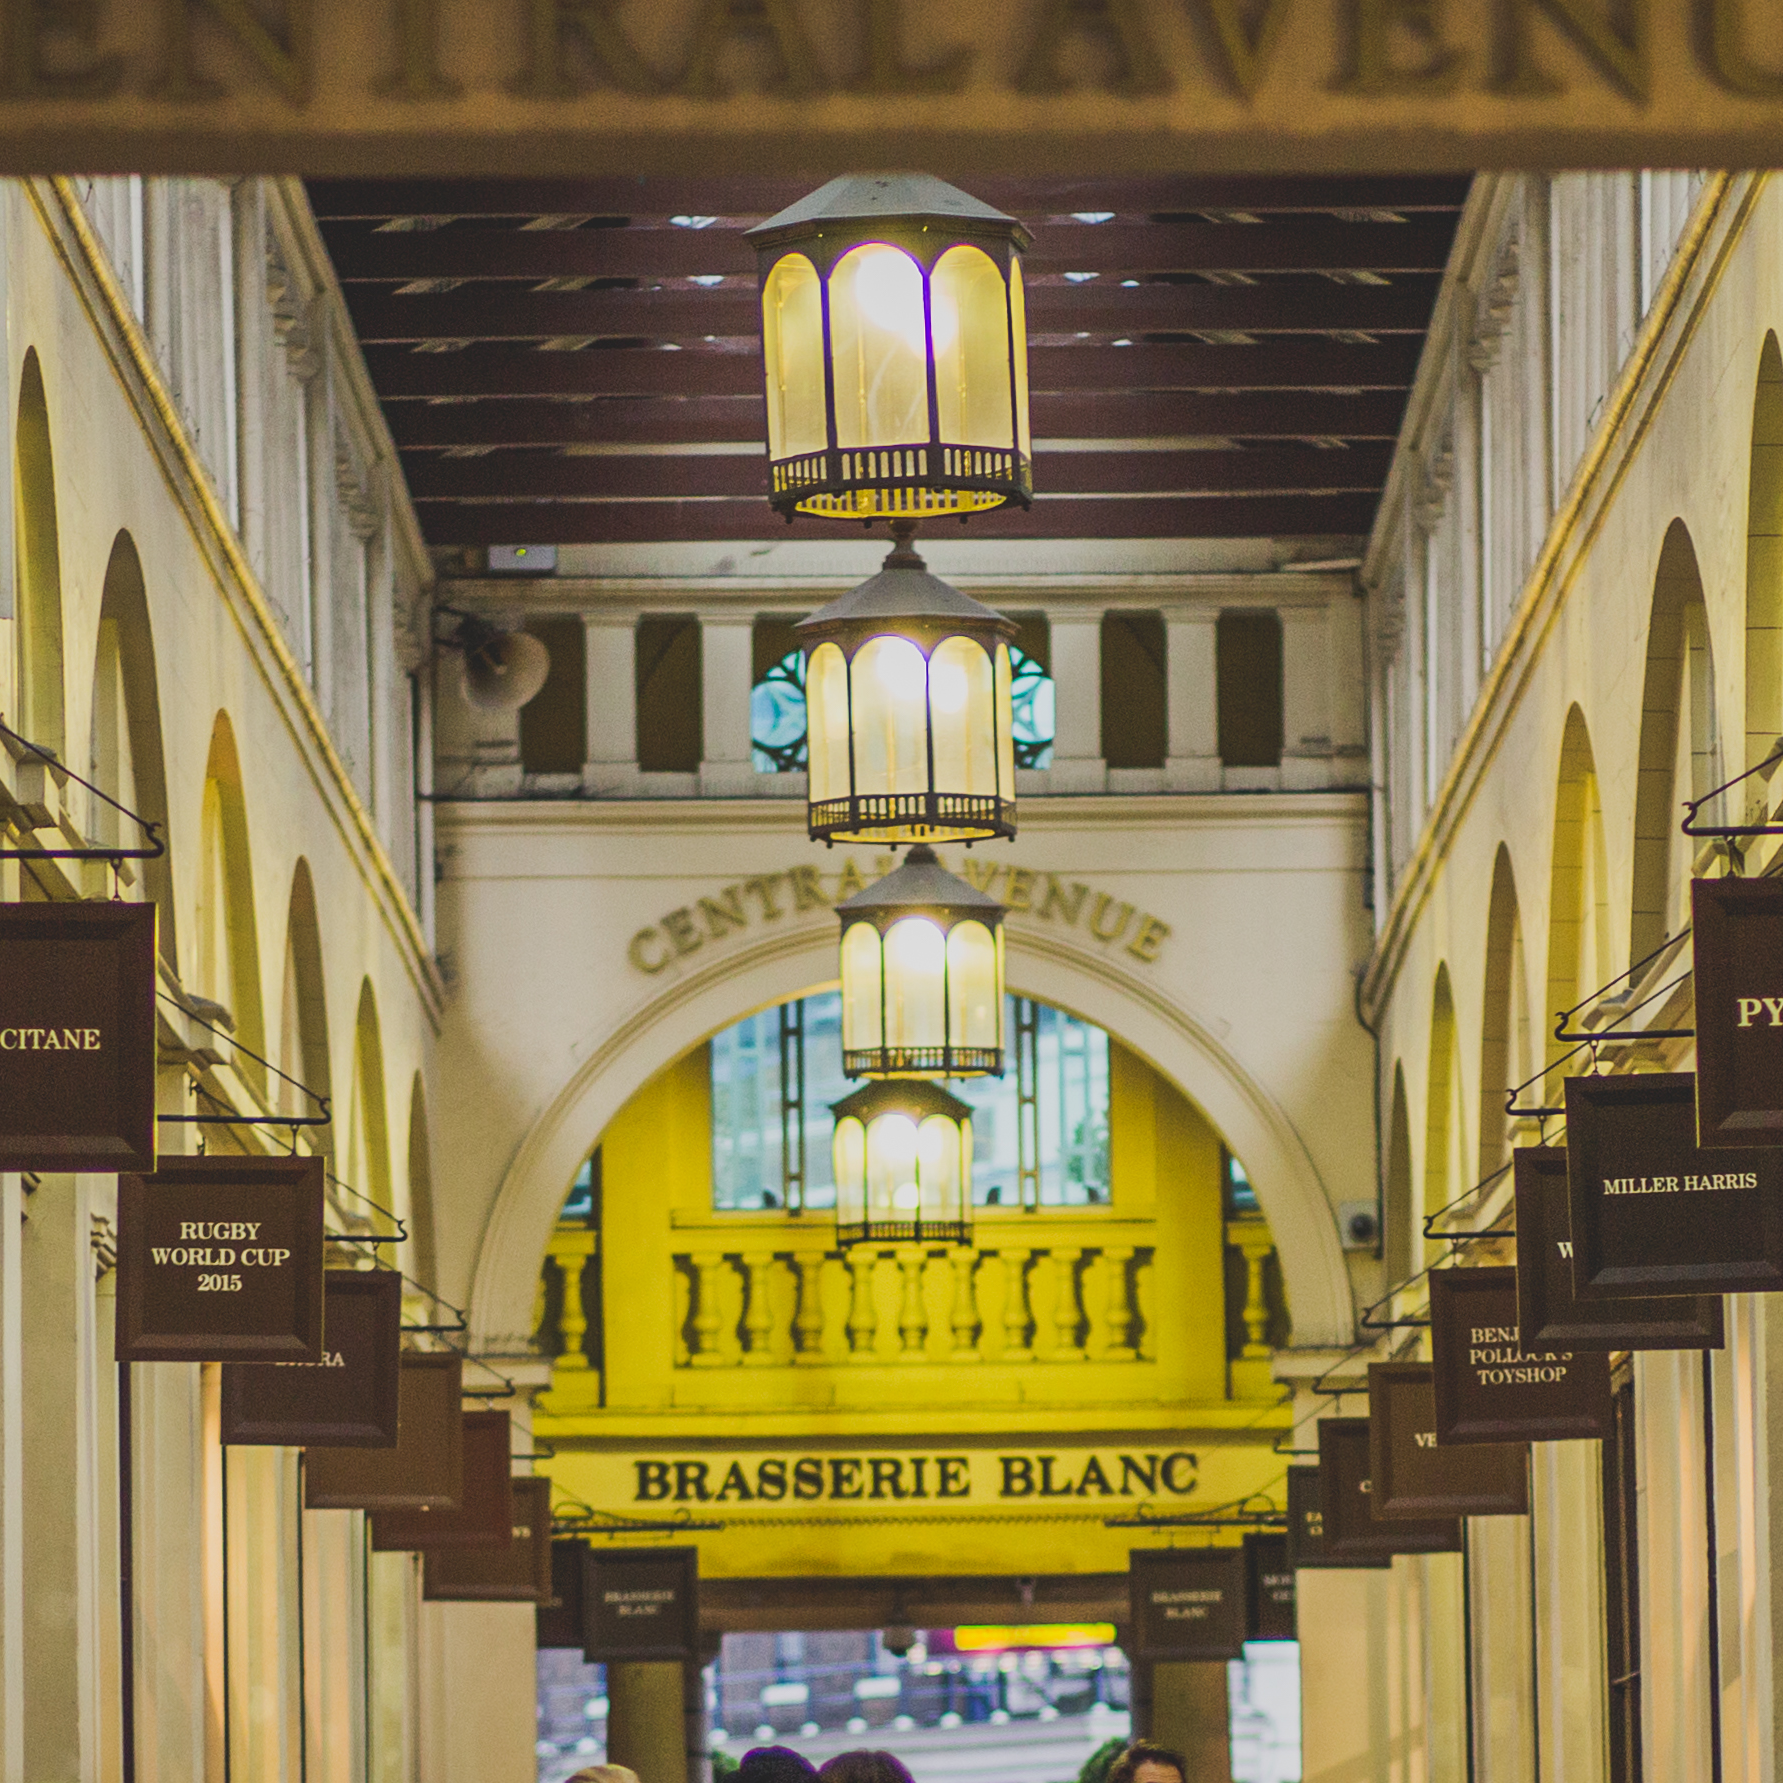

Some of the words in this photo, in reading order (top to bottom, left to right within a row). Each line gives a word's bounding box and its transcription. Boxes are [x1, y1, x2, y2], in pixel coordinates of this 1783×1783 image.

[938, 853, 1174, 964] VENUE
[1603, 1176, 1679, 1195] MILLER
[1684, 1172, 1758, 1191] HARRIS
[180, 1222, 261, 1240] RUGBY
[151, 1247, 236, 1265] WORLD
[240, 1248, 291, 1266] CUP
[197, 1274, 243, 1291] 2015
[1471, 1327, 1520, 1343] BENJ
[1477, 1366, 1567, 1385] TOYSHOP
[634, 1457, 970, 1501] BRASSERIE
[999, 1452, 1199, 1497] BLANC
